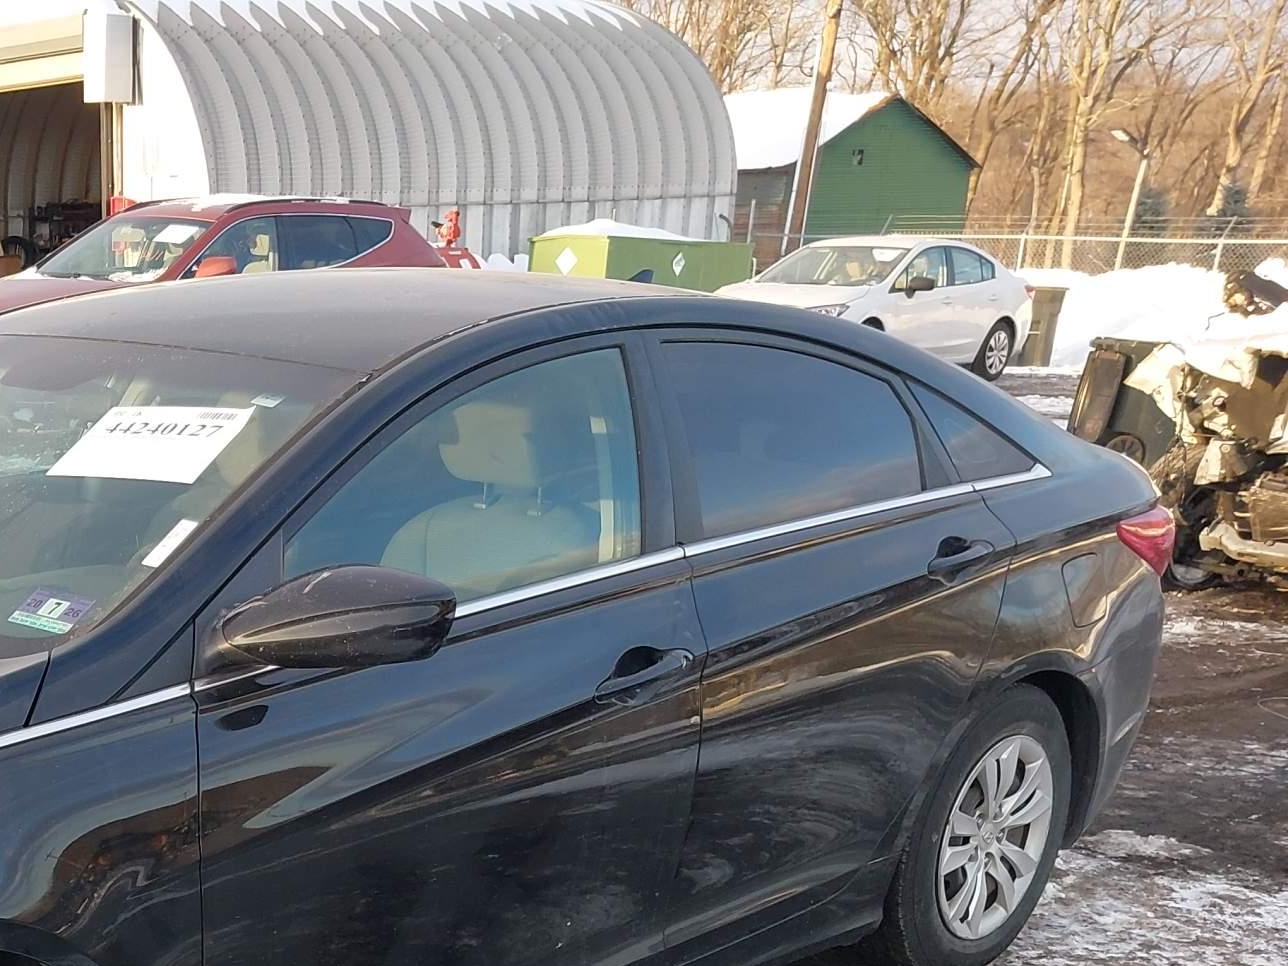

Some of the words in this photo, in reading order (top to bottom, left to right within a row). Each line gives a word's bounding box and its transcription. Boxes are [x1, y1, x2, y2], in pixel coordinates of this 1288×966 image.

[105, 422, 223, 438] 44240127
[27, 598, 44, 609] 20
[48, 601, 63, 615] 7
[64, 607, 82, 618] 26
